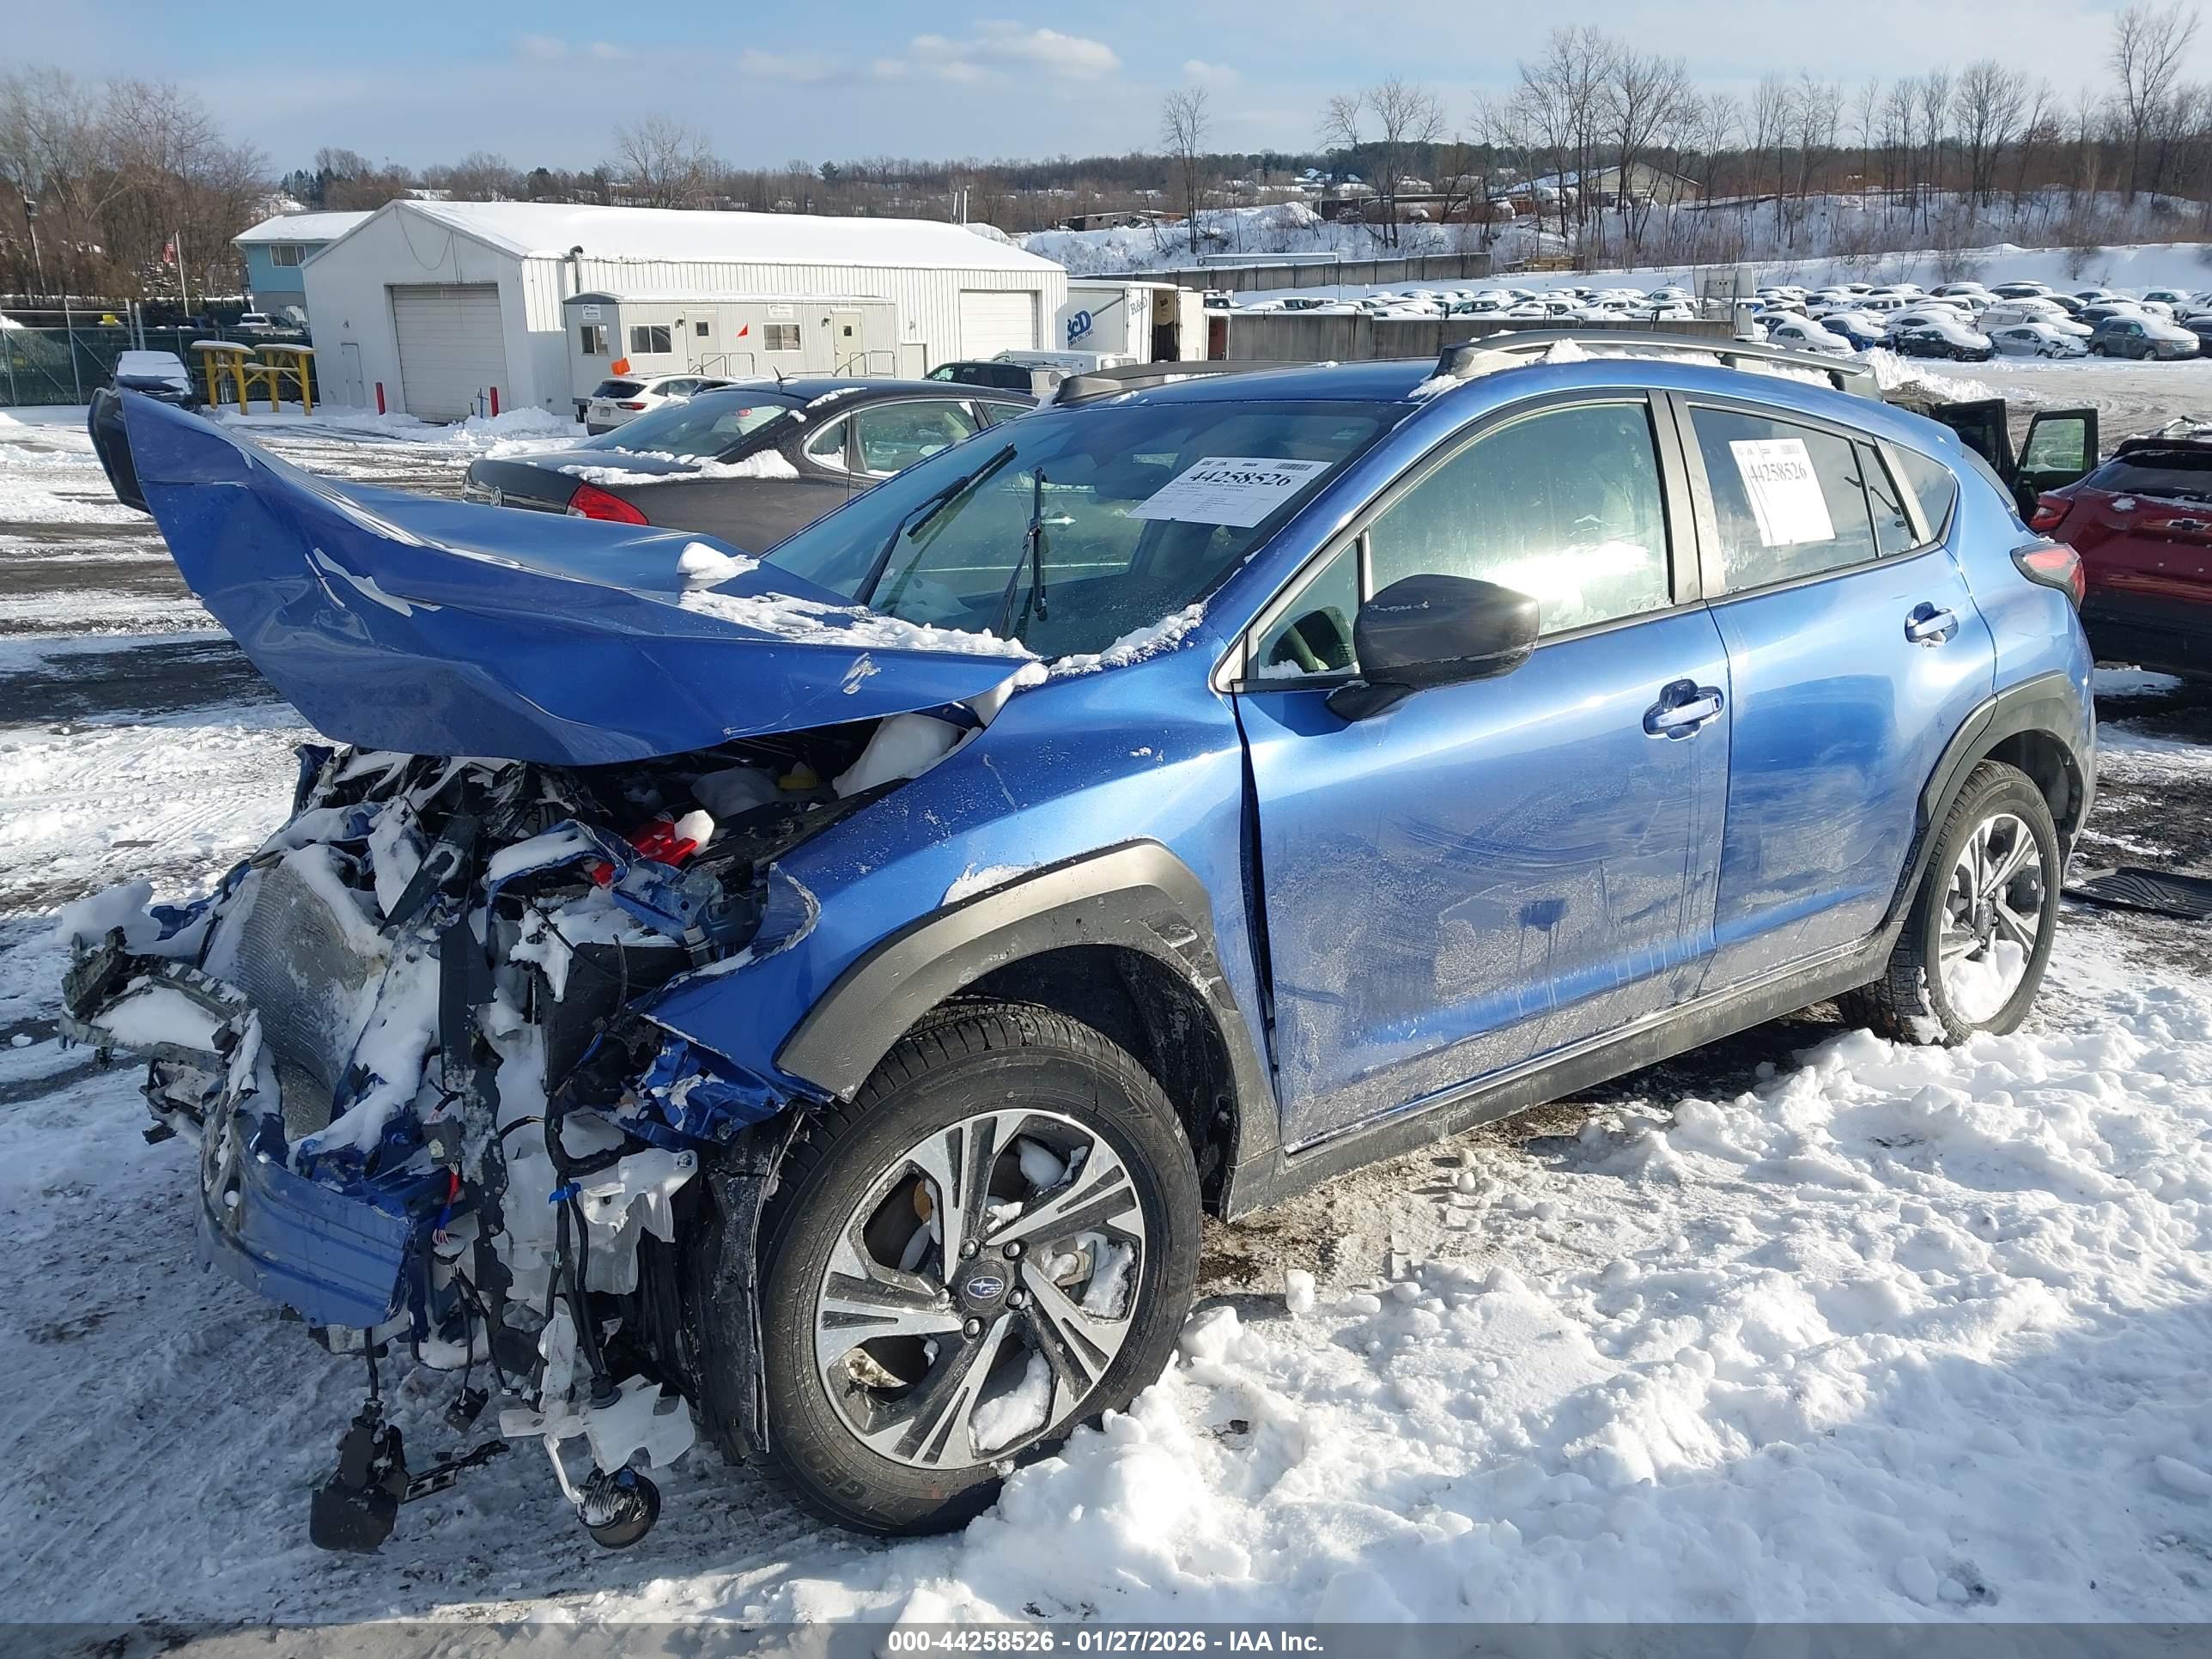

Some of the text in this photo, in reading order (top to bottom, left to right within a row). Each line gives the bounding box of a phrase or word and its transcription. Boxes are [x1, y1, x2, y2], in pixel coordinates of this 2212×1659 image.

[1129, 296, 1148, 315] R&D
[1189, 471, 1291, 487] 44258526
[1749, 461, 1807, 482] 44258526
